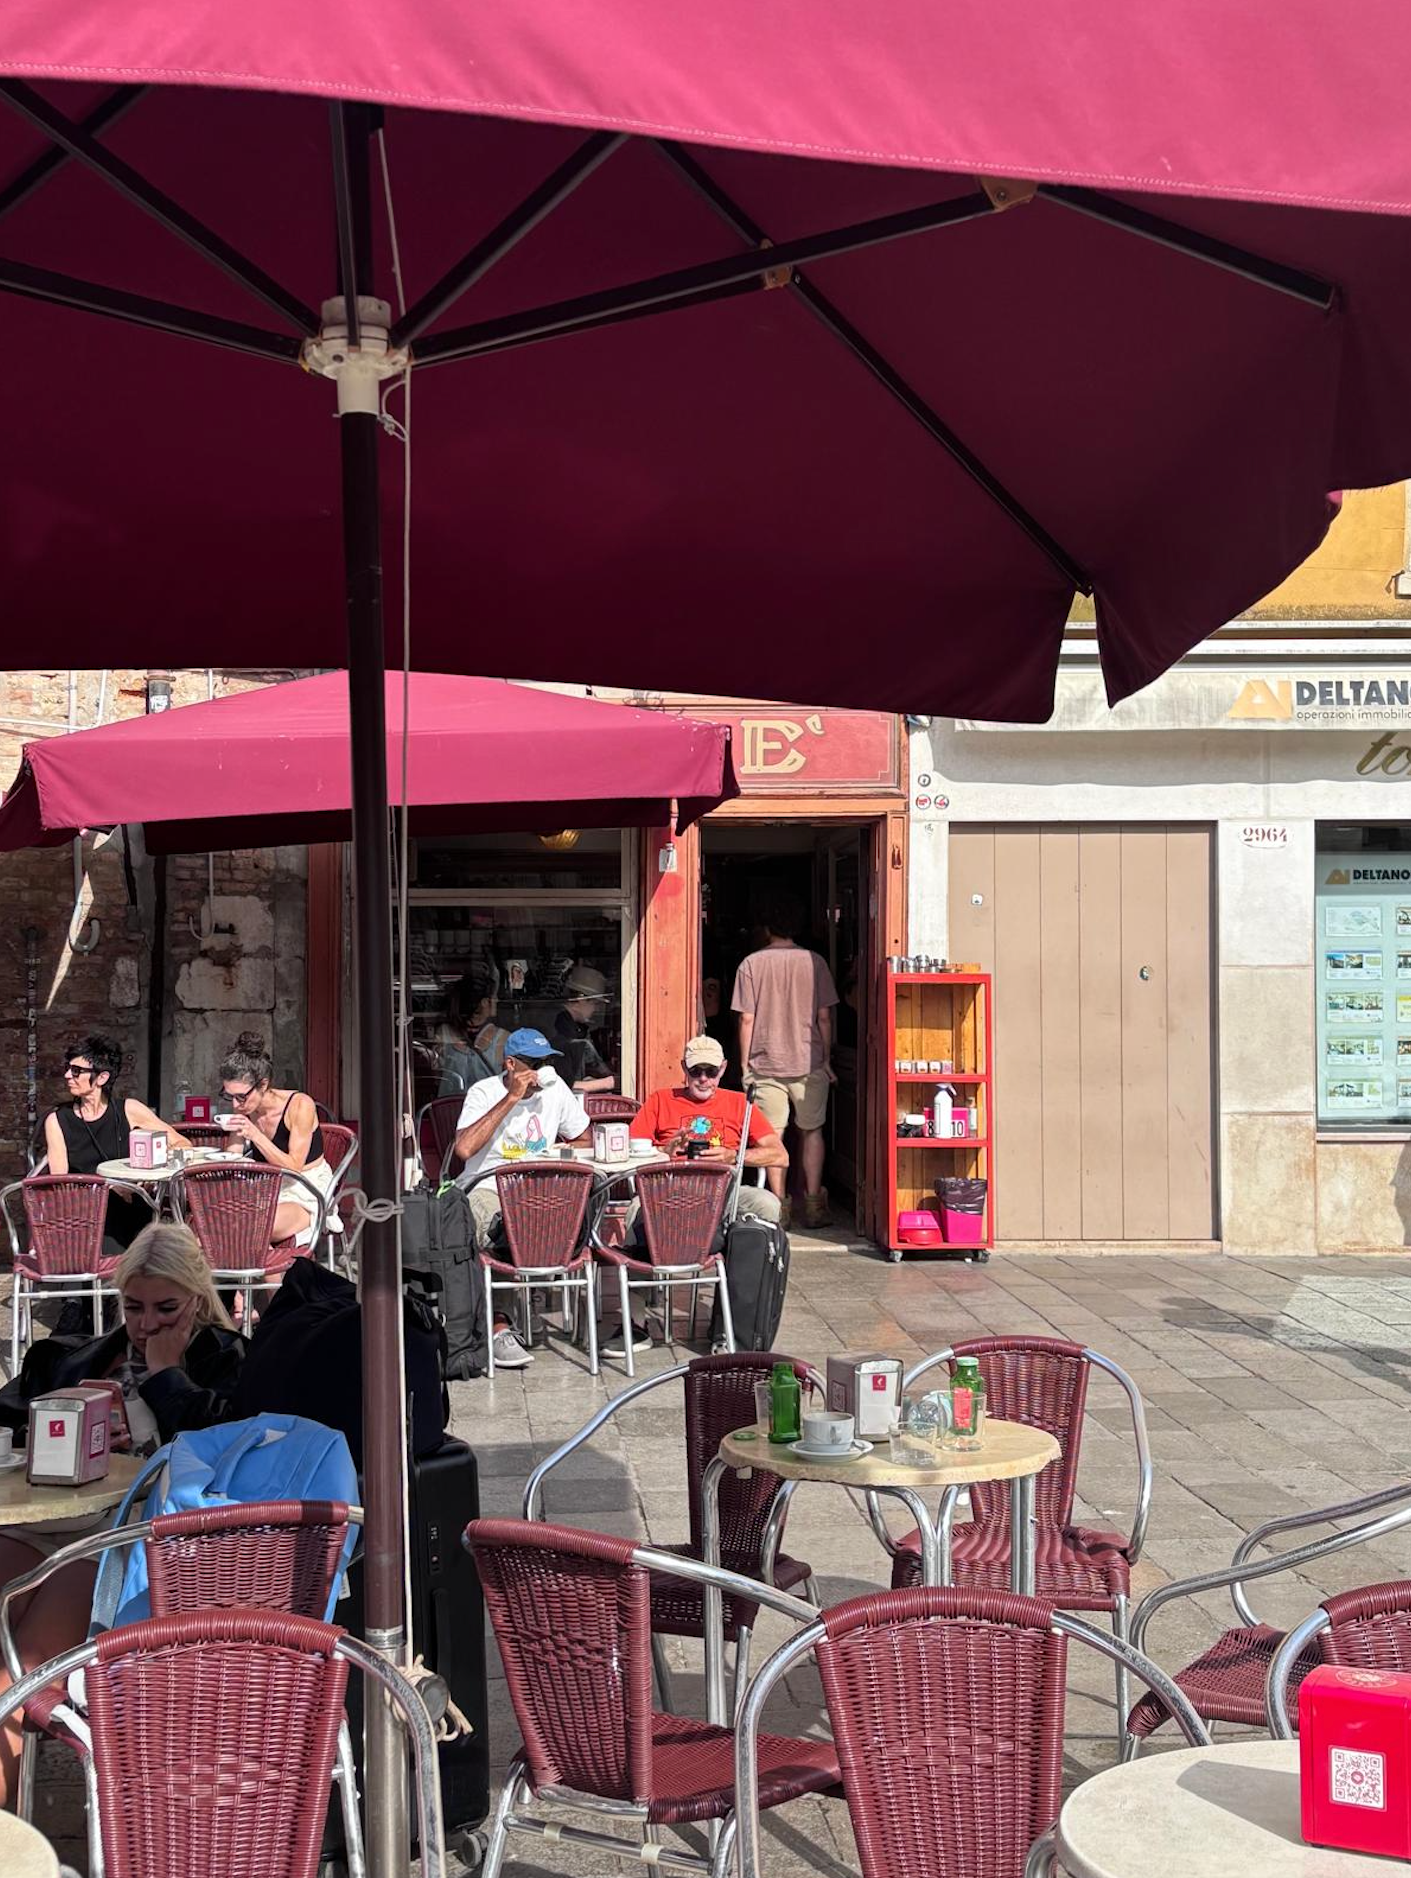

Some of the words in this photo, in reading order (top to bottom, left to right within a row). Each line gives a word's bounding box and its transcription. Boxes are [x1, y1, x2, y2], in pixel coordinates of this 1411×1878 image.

[1296, 681, 1411, 705] DELTAN
[1296, 709, 1355, 721] operazioni
[1356, 731, 1411, 776] to
[1243, 827, 1288, 843] 2964
[1353, 869, 1411, 880] DELTANO
